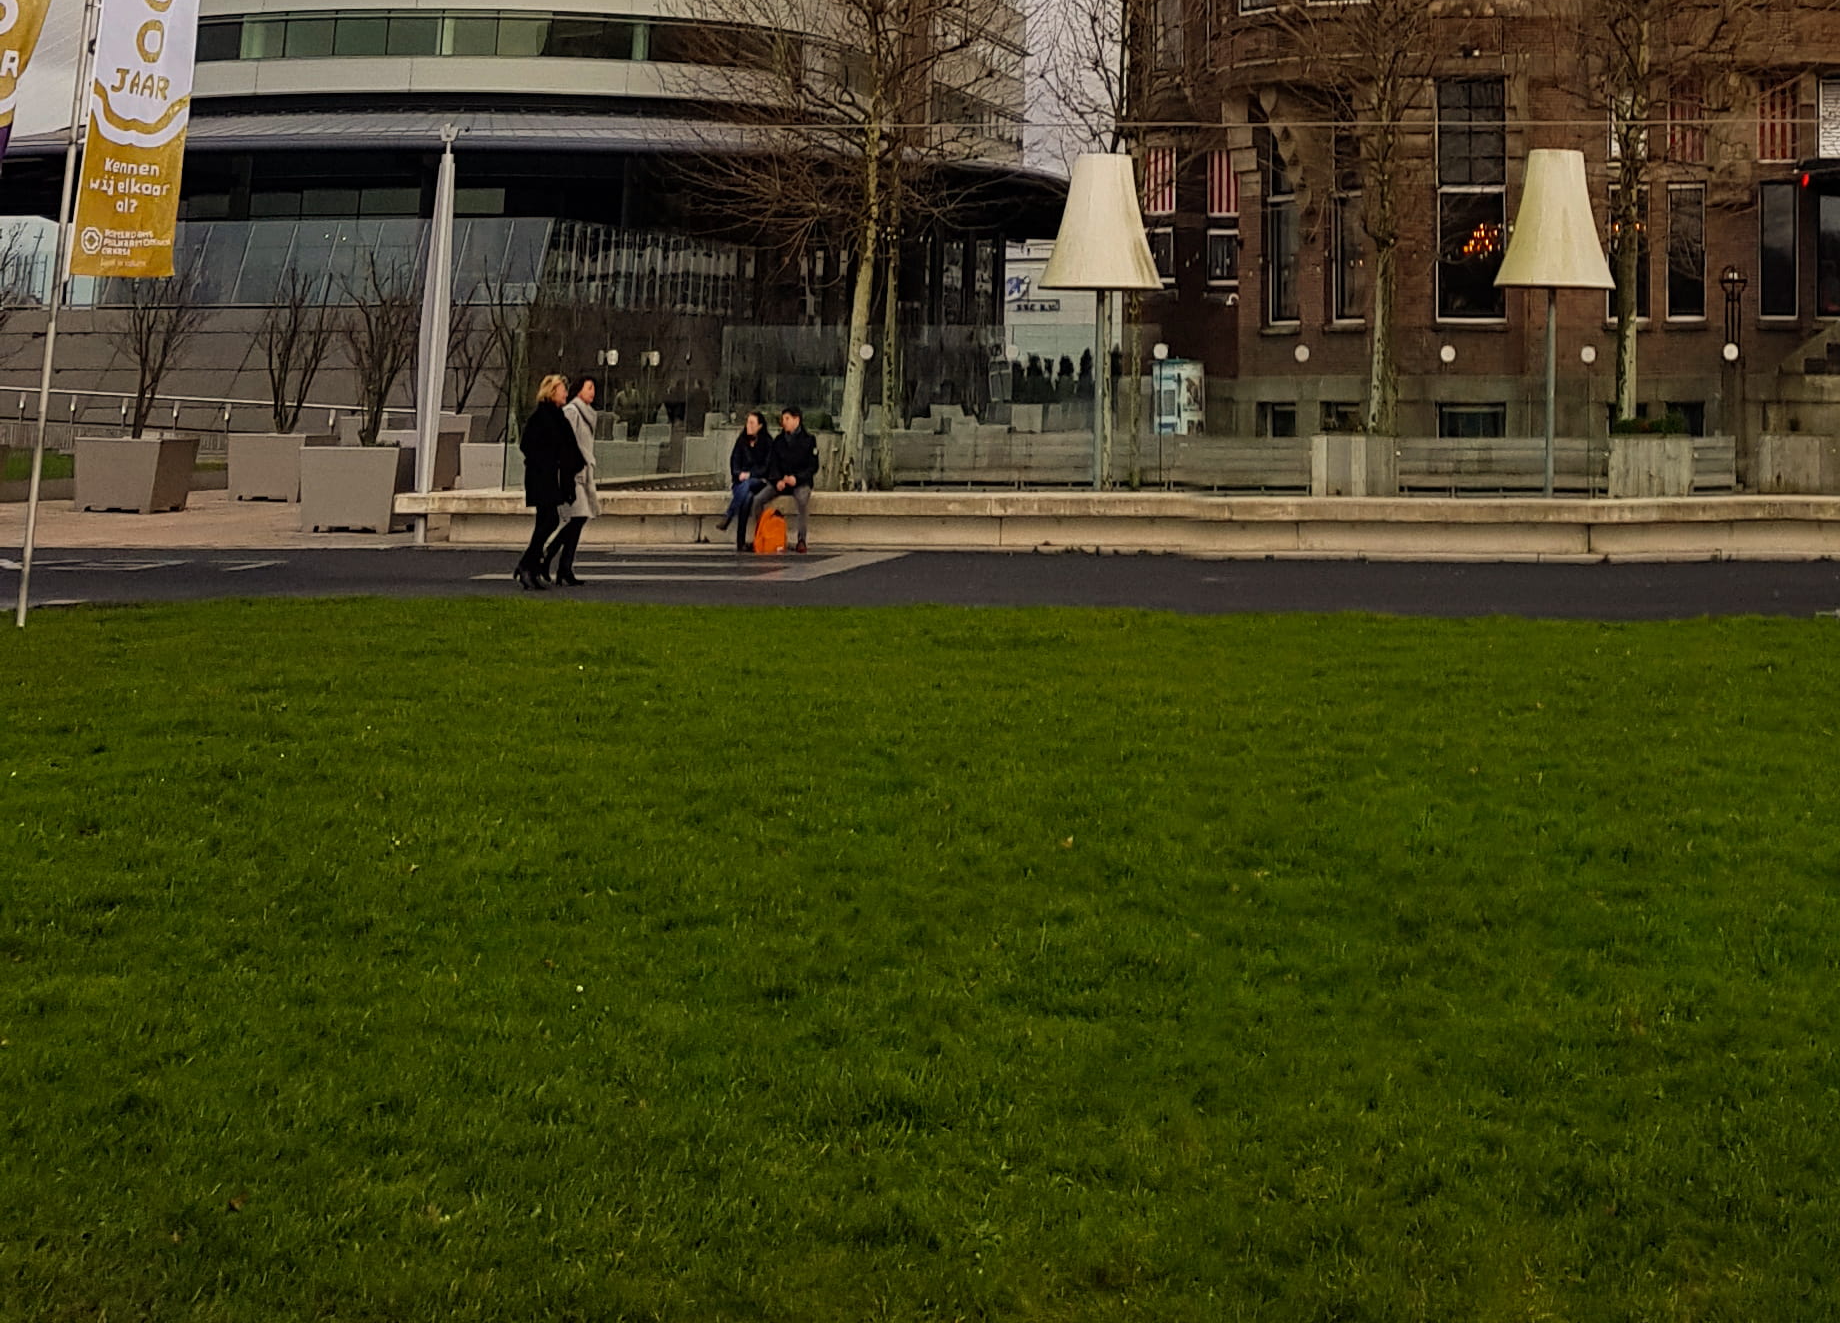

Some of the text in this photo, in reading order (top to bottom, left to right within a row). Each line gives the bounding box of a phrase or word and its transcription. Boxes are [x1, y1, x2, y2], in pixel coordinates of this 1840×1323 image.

[110, 67, 171, 101] JAAR
[103, 156, 160, 177] Kennen
[89, 174, 170, 196] wij elkaar
[115, 196, 138, 213] al?
